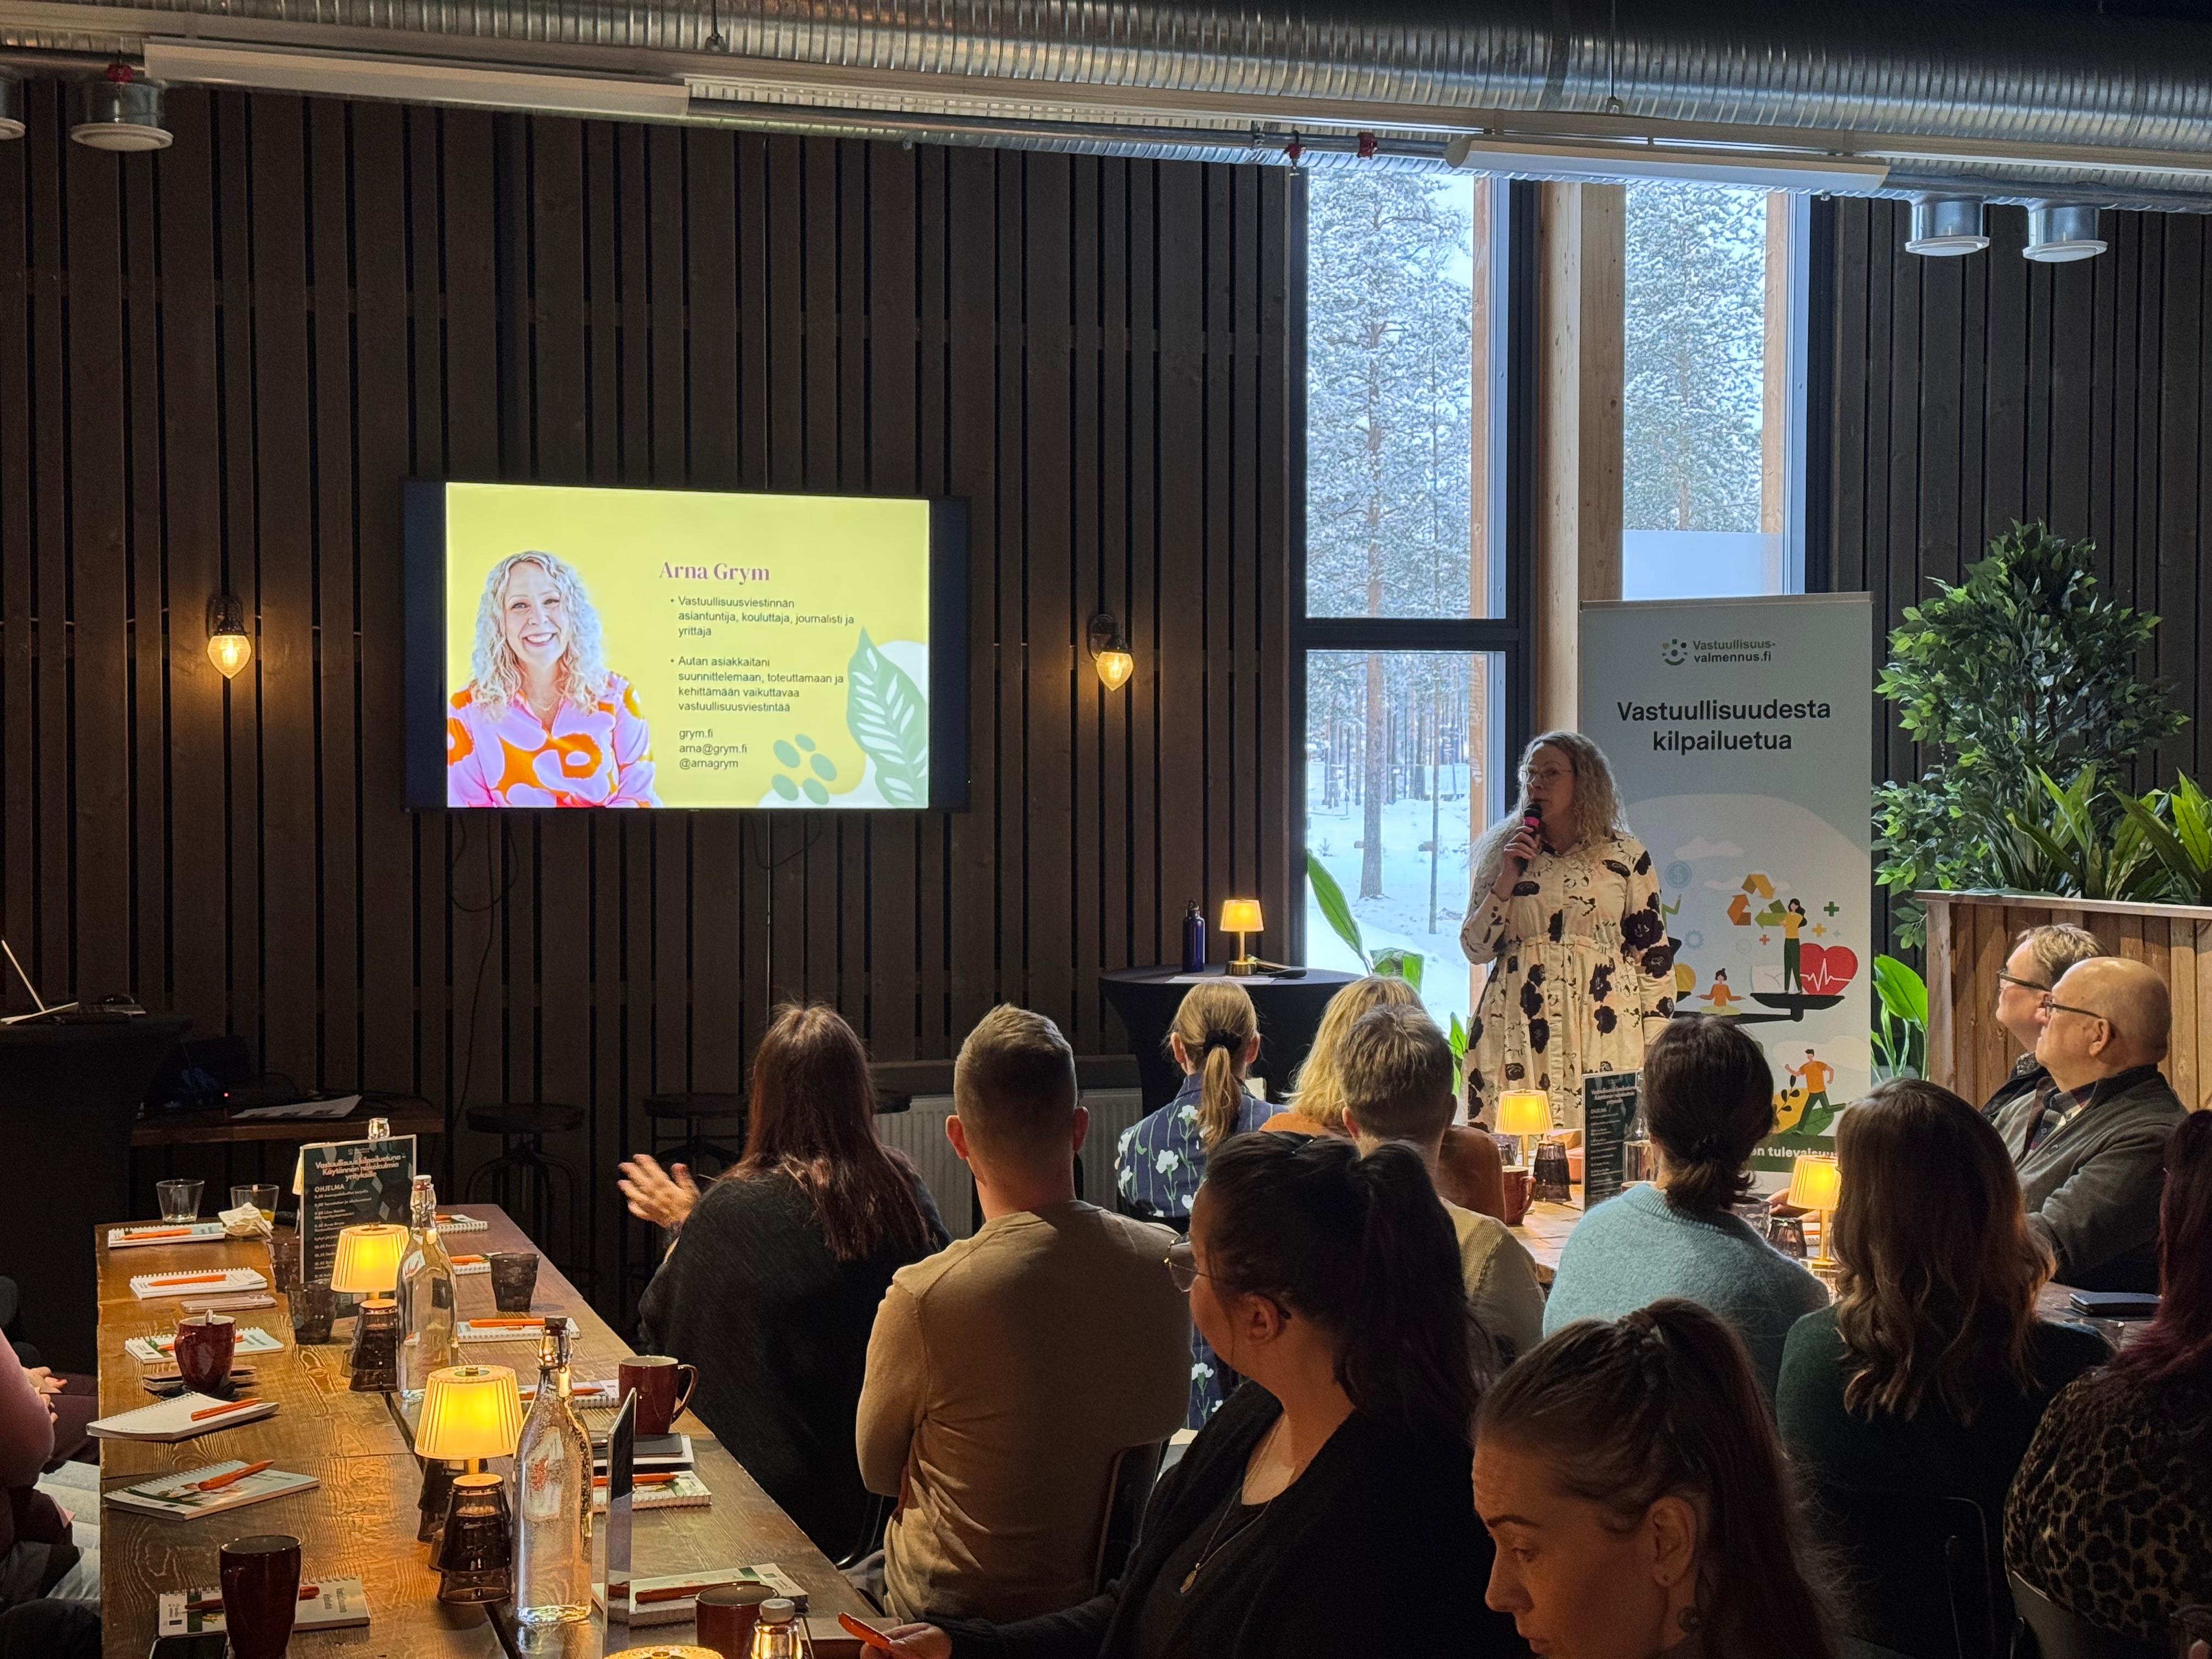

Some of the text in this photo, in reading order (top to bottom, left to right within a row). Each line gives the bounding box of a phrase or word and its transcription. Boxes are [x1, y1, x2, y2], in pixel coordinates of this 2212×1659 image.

[659, 561, 770, 585] Arna Grym
[678, 596, 794, 608] Vastuullisuusviestinnän
[678, 611, 854, 627] asiantuntija, kouluttaja, journalisti ja
[1692, 639, 1776, 651] Vastuullisuus-
[678, 656, 770, 667] Autan asiakkaitani
[1694, 651, 1772, 663] valmennus.fi
[678, 672, 844, 686] suunnittelemaan, toteuttamaan ja
[743, 687, 800, 697] vaikuttavaa
[1617, 698, 1831, 721] Vastuullisuudesta
[679, 729, 714, 740] grym.fi
[1653, 730, 1792, 755] kilpailuetua
[679, 743, 747, 755] arna@grym.fi
[679, 758, 738, 770] @arnagrym
[314, 1183, 345, 1193] OHJELMA
